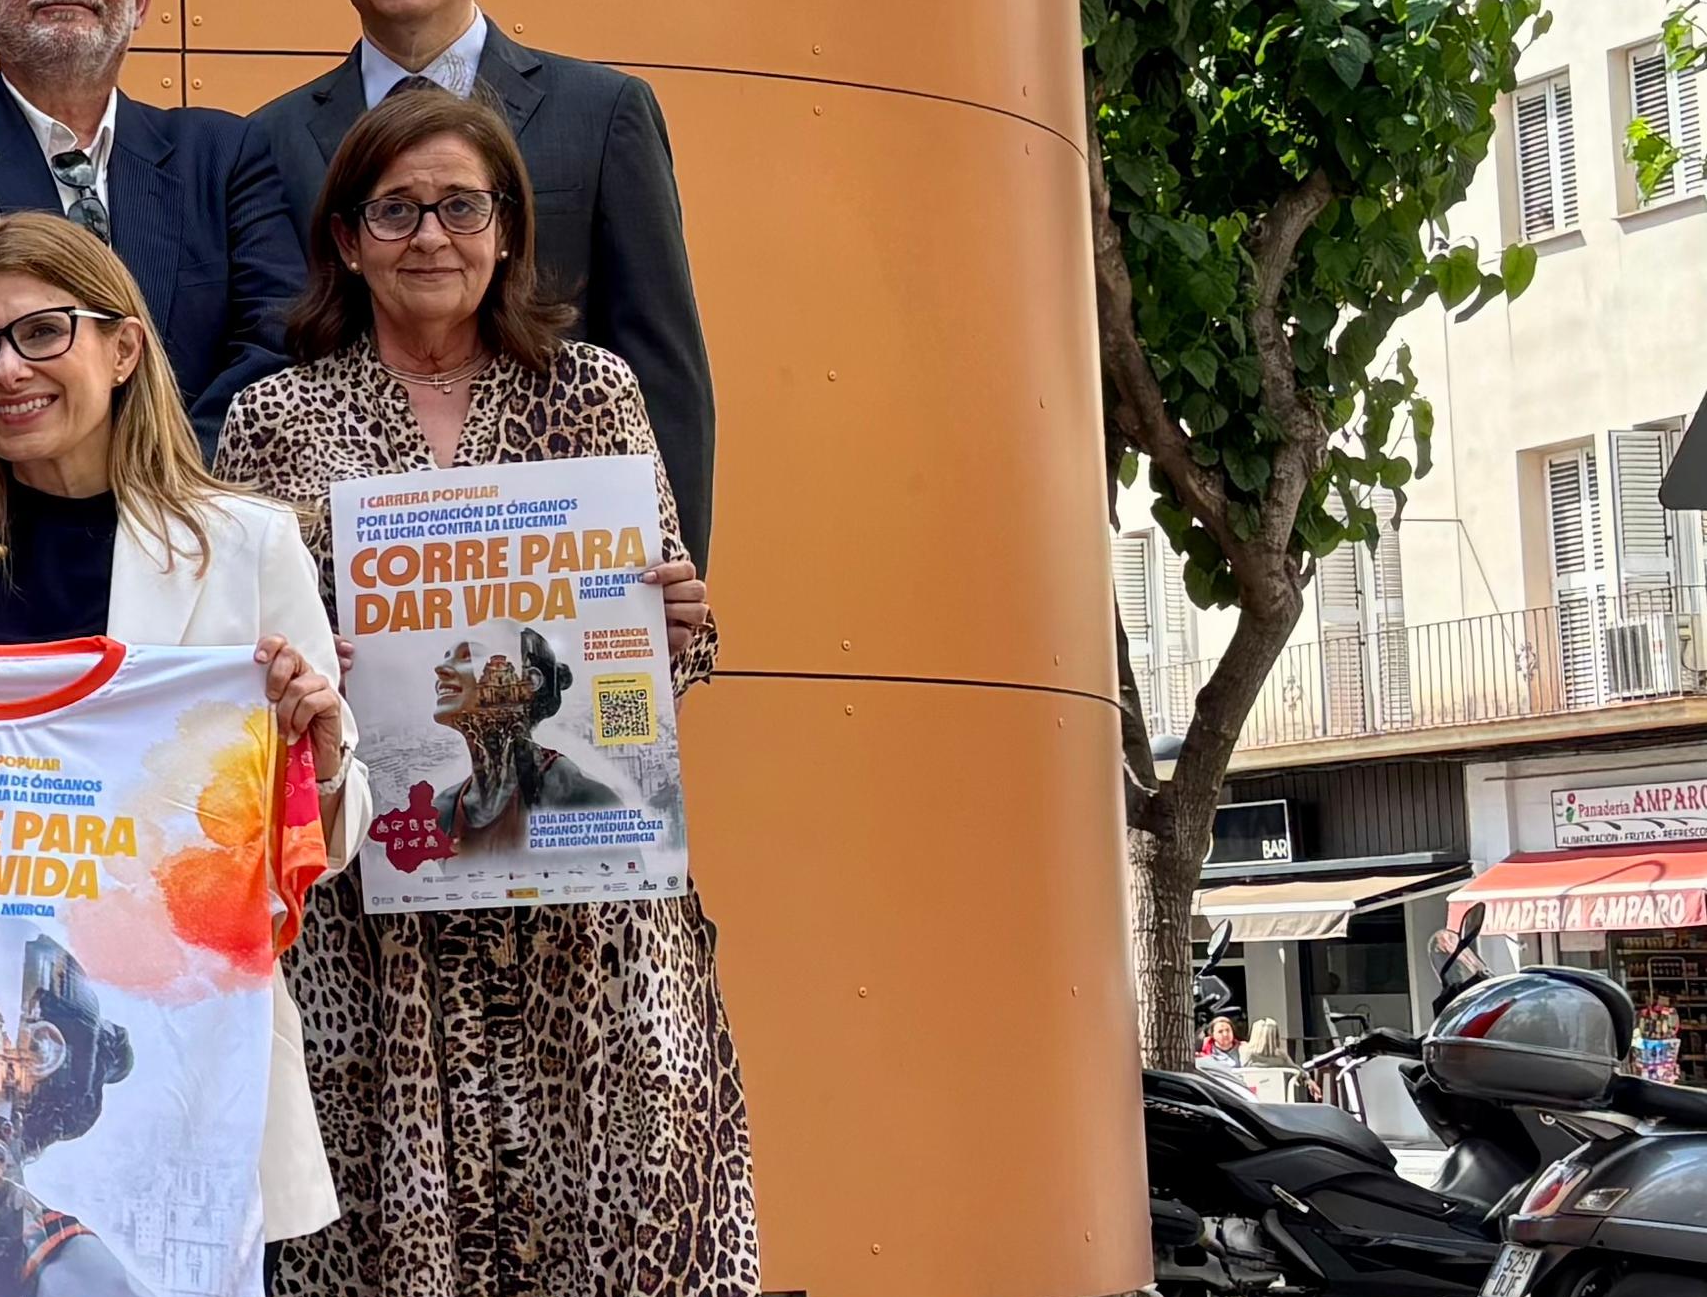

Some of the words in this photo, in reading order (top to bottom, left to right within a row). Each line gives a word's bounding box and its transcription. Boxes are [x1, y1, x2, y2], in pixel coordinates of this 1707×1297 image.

[367, 493, 429, 509] CARRERA
[433, 485, 499, 503] POPULAR
[357, 516, 387, 529] POR
[389, 514, 405, 525] LA
[407, 504, 484, 525] DONACIÓN
[487, 505, 504, 517] DE
[507, 498, 578, 515] ÓRGANOS
[357, 531, 365, 543] Y
[367, 529, 382, 541] LA
[385, 525, 425, 541] LUCHA
[428, 521, 483, 537] CONTRA
[485, 519, 500, 532] LA
[503, 513, 567, 531] LEUCEMIA
[350, 537, 509, 589] CORRE
[519, 527, 647, 576] PARA
[579, 576, 593, 587] 10
[595, 575, 611, 586] DE
[579, 587, 625, 599] MURCIA
[355, 587, 453, 635] DAR
[463, 577, 577, 627] VIDA
[11, 776, 29, 788] DE
[30, 774, 103, 793] ÓRGANOS
[13, 791, 29, 803] LA
[31, 792, 95, 807] LEUCEMIA
[11, 810, 138, 857] PARA
[1262, 839, 1287, 859] BAR
[1, 903, 55, 917] MURCIA
[1484, 897, 1581, 931] ANADERIA
[1591, 893, 1685, 927] AMPARO
[1503, 1249, 1536, 1274] 5251
